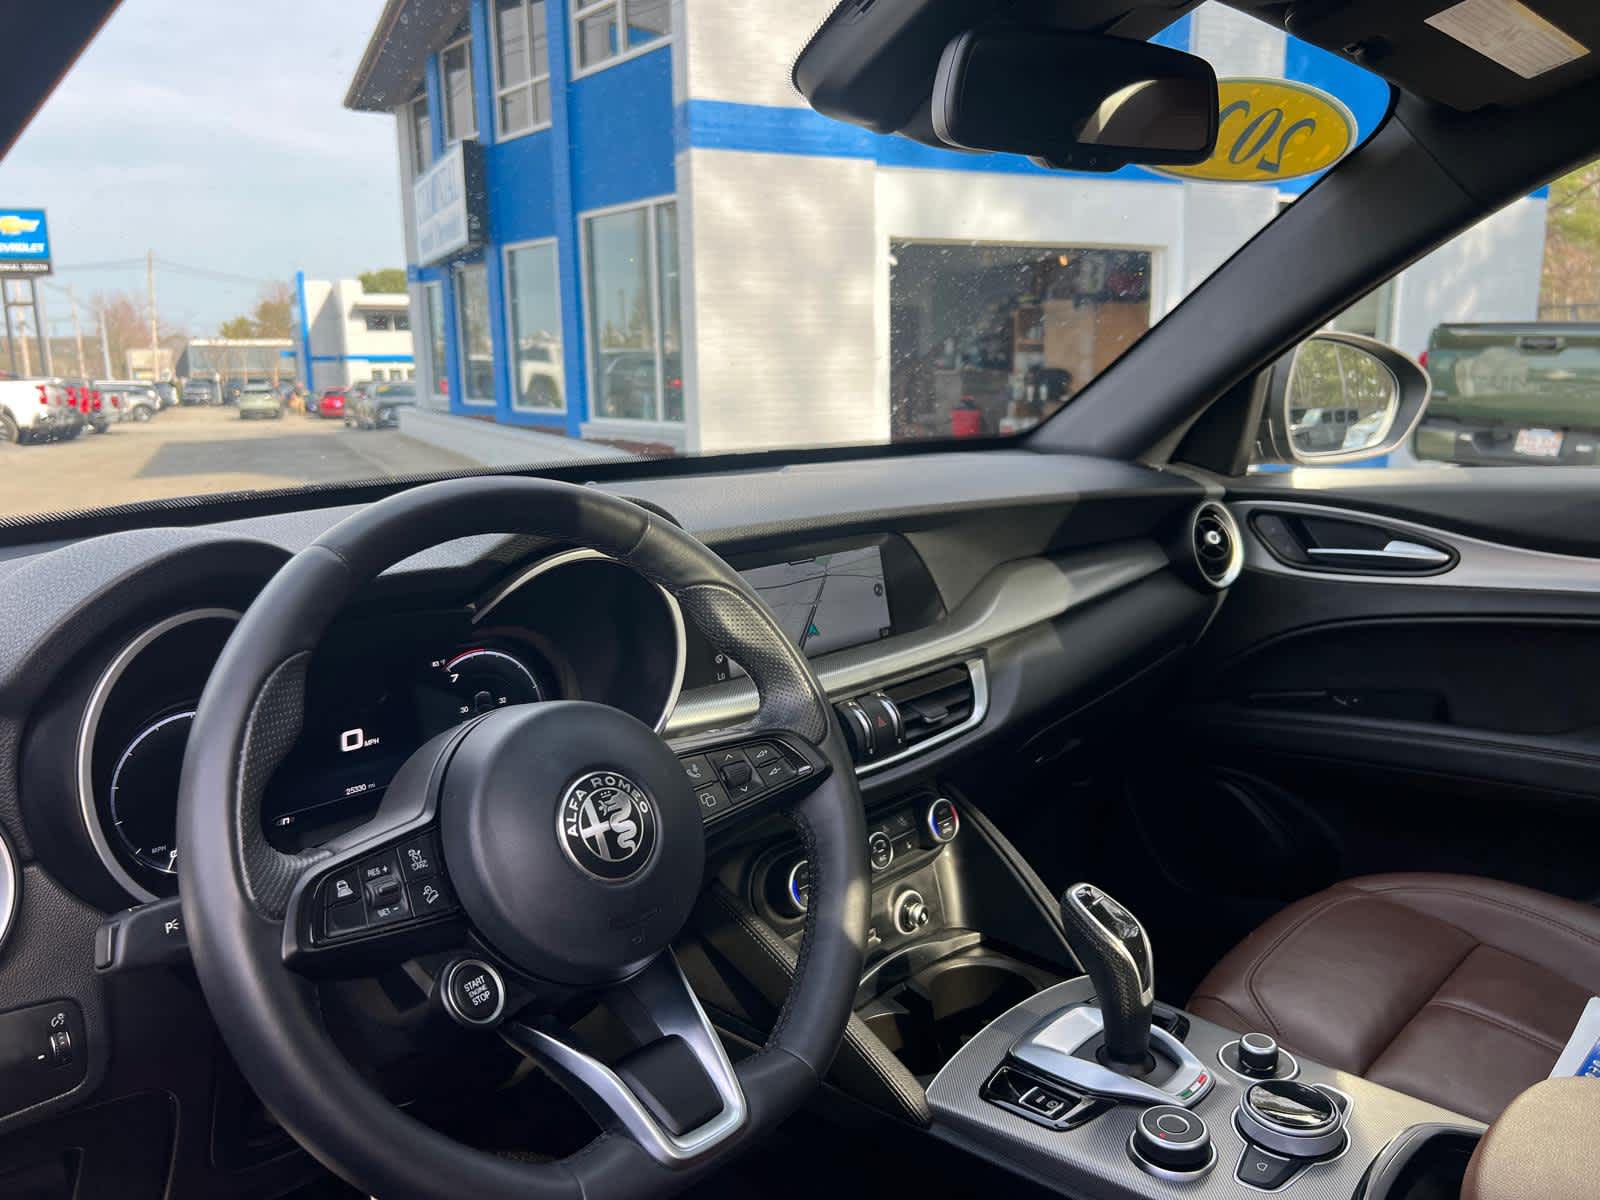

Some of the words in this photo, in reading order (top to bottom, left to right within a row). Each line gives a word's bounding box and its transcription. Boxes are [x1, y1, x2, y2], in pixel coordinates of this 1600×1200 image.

[449, 673, 459, 683] 7
[341, 728, 364, 752] 0
[364, 737, 380, 747] MPH
[345, 783, 367, 795] 25330
[566, 788, 588, 838] ALFA
[590, 775, 649, 814] ROMEO
[151, 845, 167, 854] MPH
[367, 866, 381, 877] RES
[463, 975, 485, 993] START
[472, 990, 490, 1006] STOP
